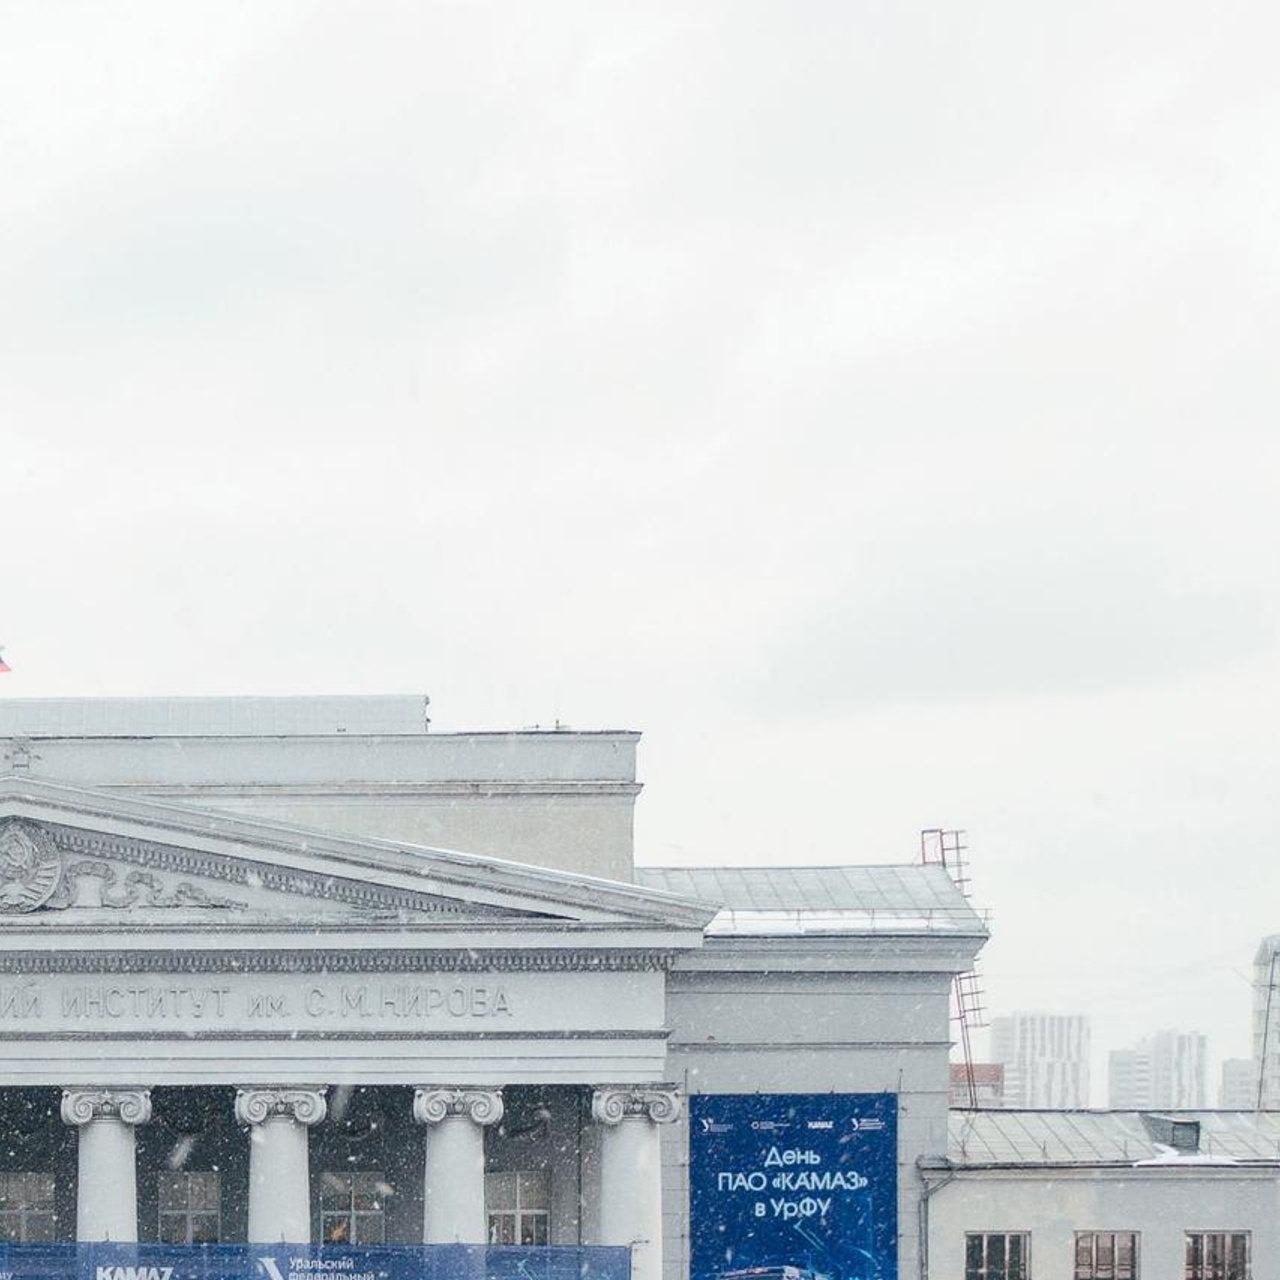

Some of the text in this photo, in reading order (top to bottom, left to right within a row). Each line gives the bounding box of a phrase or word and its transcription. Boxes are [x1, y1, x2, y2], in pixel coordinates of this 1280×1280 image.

[61, 984, 230, 1019] ИНСТИТУТ
[764, 1146, 821, 1168] День
[717, 1170, 869, 1191] ПАО «КАМАЗ»
[755, 1196, 832, 1220] в УрФУ
[288, 1257, 355, 1270] Уральский
